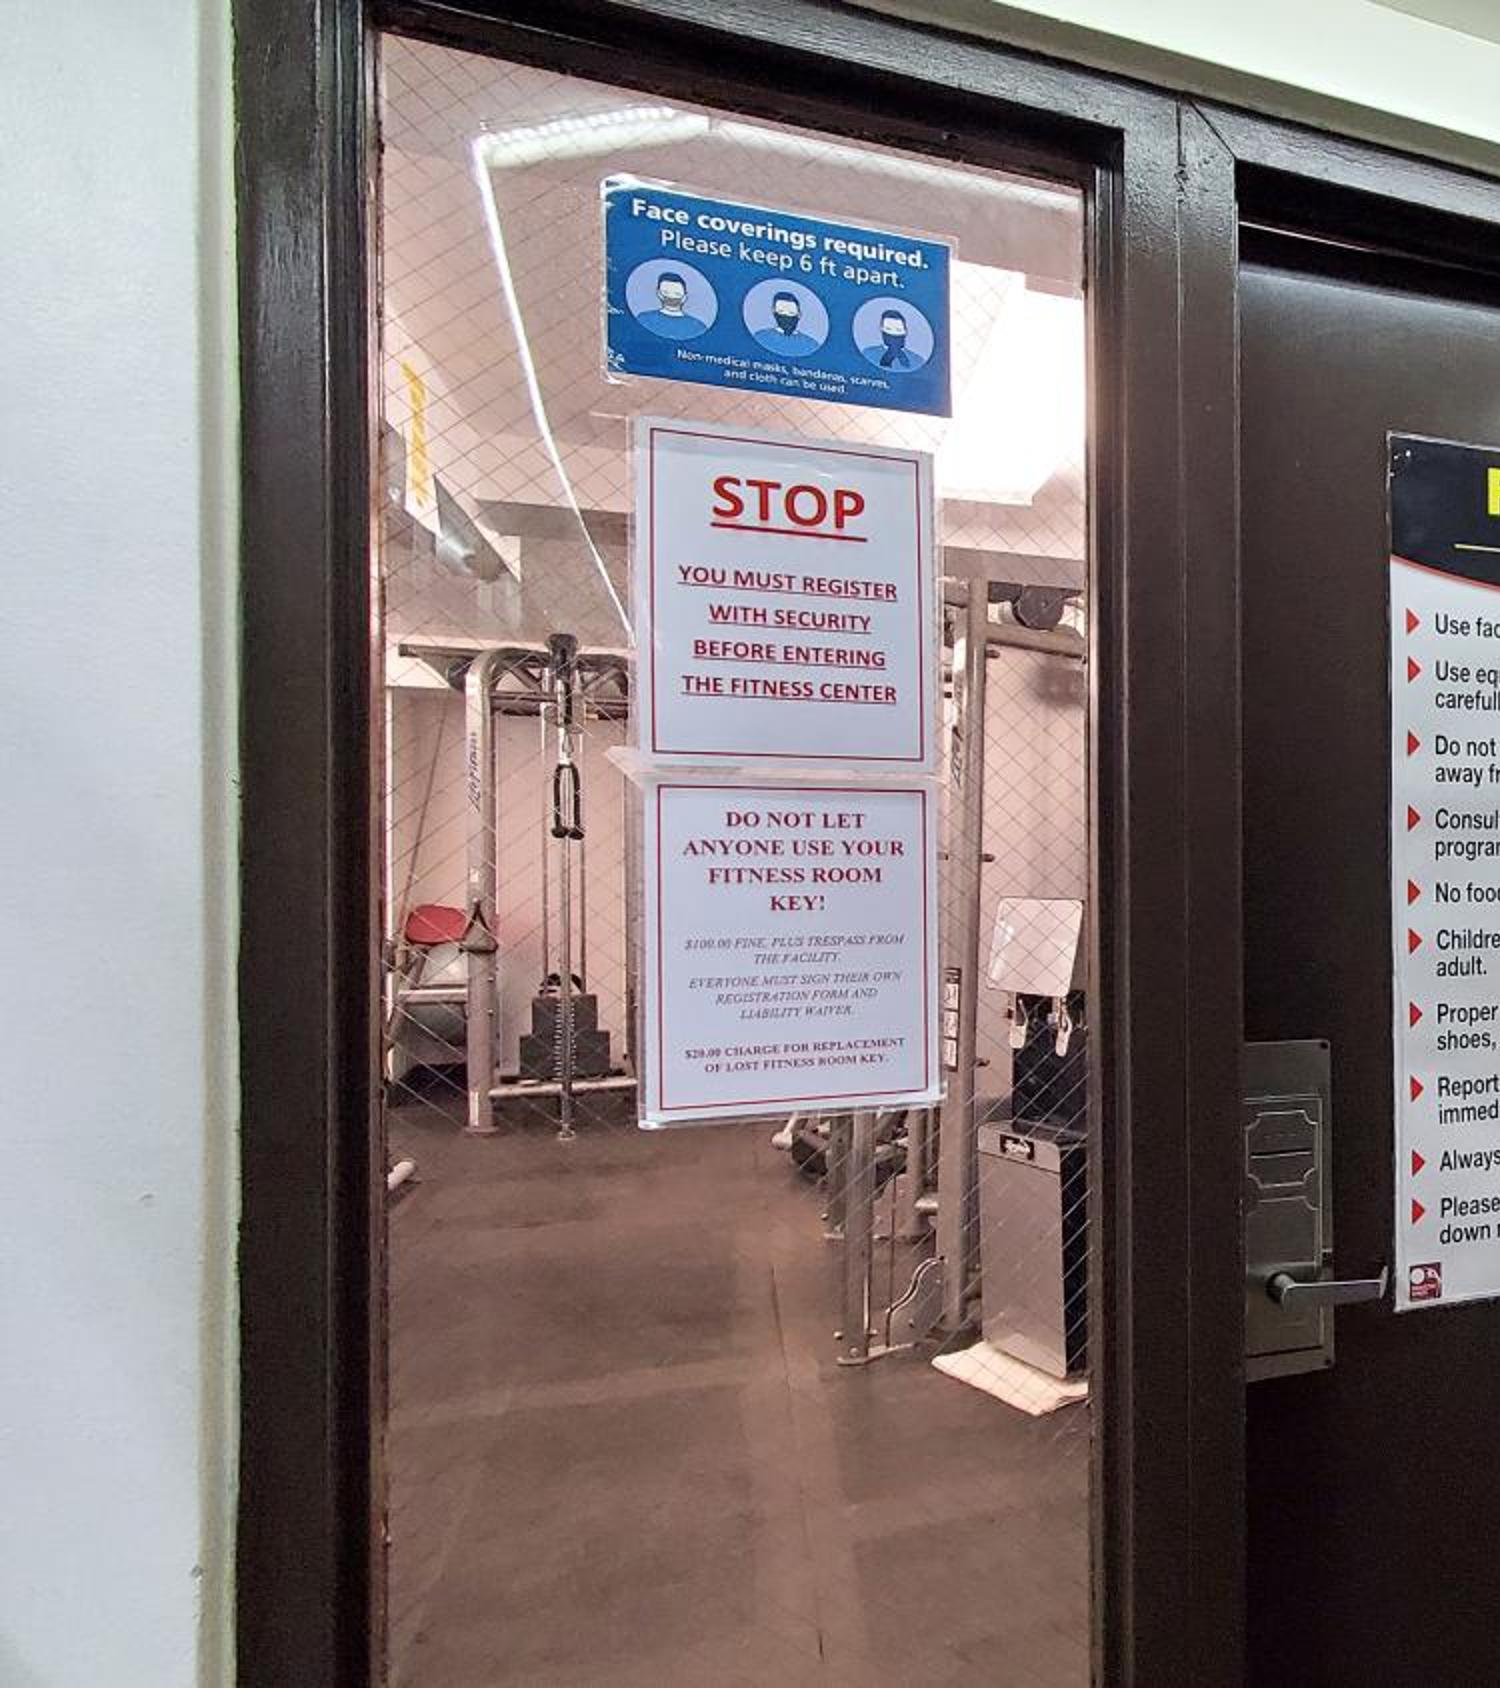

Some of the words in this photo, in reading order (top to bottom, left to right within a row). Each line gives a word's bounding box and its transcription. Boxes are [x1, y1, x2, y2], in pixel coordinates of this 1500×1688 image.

[632, 197, 689, 225] Face
[697, 214, 816, 250] coverings
[823, 237, 928, 269] required.
[660, 228, 732, 258] Please
[739, 241, 793, 271] keep
[799, 253, 812, 272] 6
[819, 256, 836, 277] ft
[843, 265, 904, 288] apart.
[724, 368, 747, 381] and
[803, 378, 817, 390] be
[713, 475, 865, 529] STOP
[679, 565, 726, 584] YOU
[734, 571, 795, 589] MUST
[803, 577, 896, 598] REGISTER
[710, 605, 766, 623] WITH
[775, 609, 870, 630] SECURITY
[1434, 612, 1471, 637] Use
[694, 640, 775, 659] BEFORE
[784, 645, 885, 666] ENTERING
[1435, 659, 1471, 683] Use
[682, 675, 722, 692] THE
[731, 678, 813, 696] FITNESS
[821, 683, 896, 701] CENTER
[1434, 735, 1461, 756] Do
[1466, 737, 1496, 757] not
[1434, 766, 1483, 788] away
[726, 811, 760, 828] DO
[767, 812, 816, 828] NOT
[823, 813, 866, 829] LET
[683, 839, 784, 856] ANYONE
[793, 840, 834, 856] USE
[841, 840, 904, 856] YOUR
[709, 867, 805, 884] FITNESS
[812, 867, 881, 883] ROOM
[770, 895, 825, 911] KEY!
[1435, 882, 1461, 903] No
[1435, 955, 1487, 977] adult.
[689, 975, 759, 990] EVERYONE
[761, 975, 797, 986] MUST
[800, 973, 830, 984] SIGN
[833, 972, 871, 984] THEIR
[715, 991, 809, 1005] REGISTRATION
[811, 989, 850, 1001] FORM
[851, 988, 878, 999] AND
[1437, 1002, 1498, 1027] Proper
[724, 1043, 780, 1057] CHARGE
[783, 1042, 811, 1053] FOR
[813, 1037, 905, 1052] REPLACEMENT
[726, 1060, 761, 1072] LOST
[764, 1057, 815, 1070] FITNESS
[818, 1055, 858, 1067] ROOM
[1437, 1073, 1500, 1100] Report
[1440, 1196, 1500, 1218] Please
[1439, 1223, 1491, 1245] down
